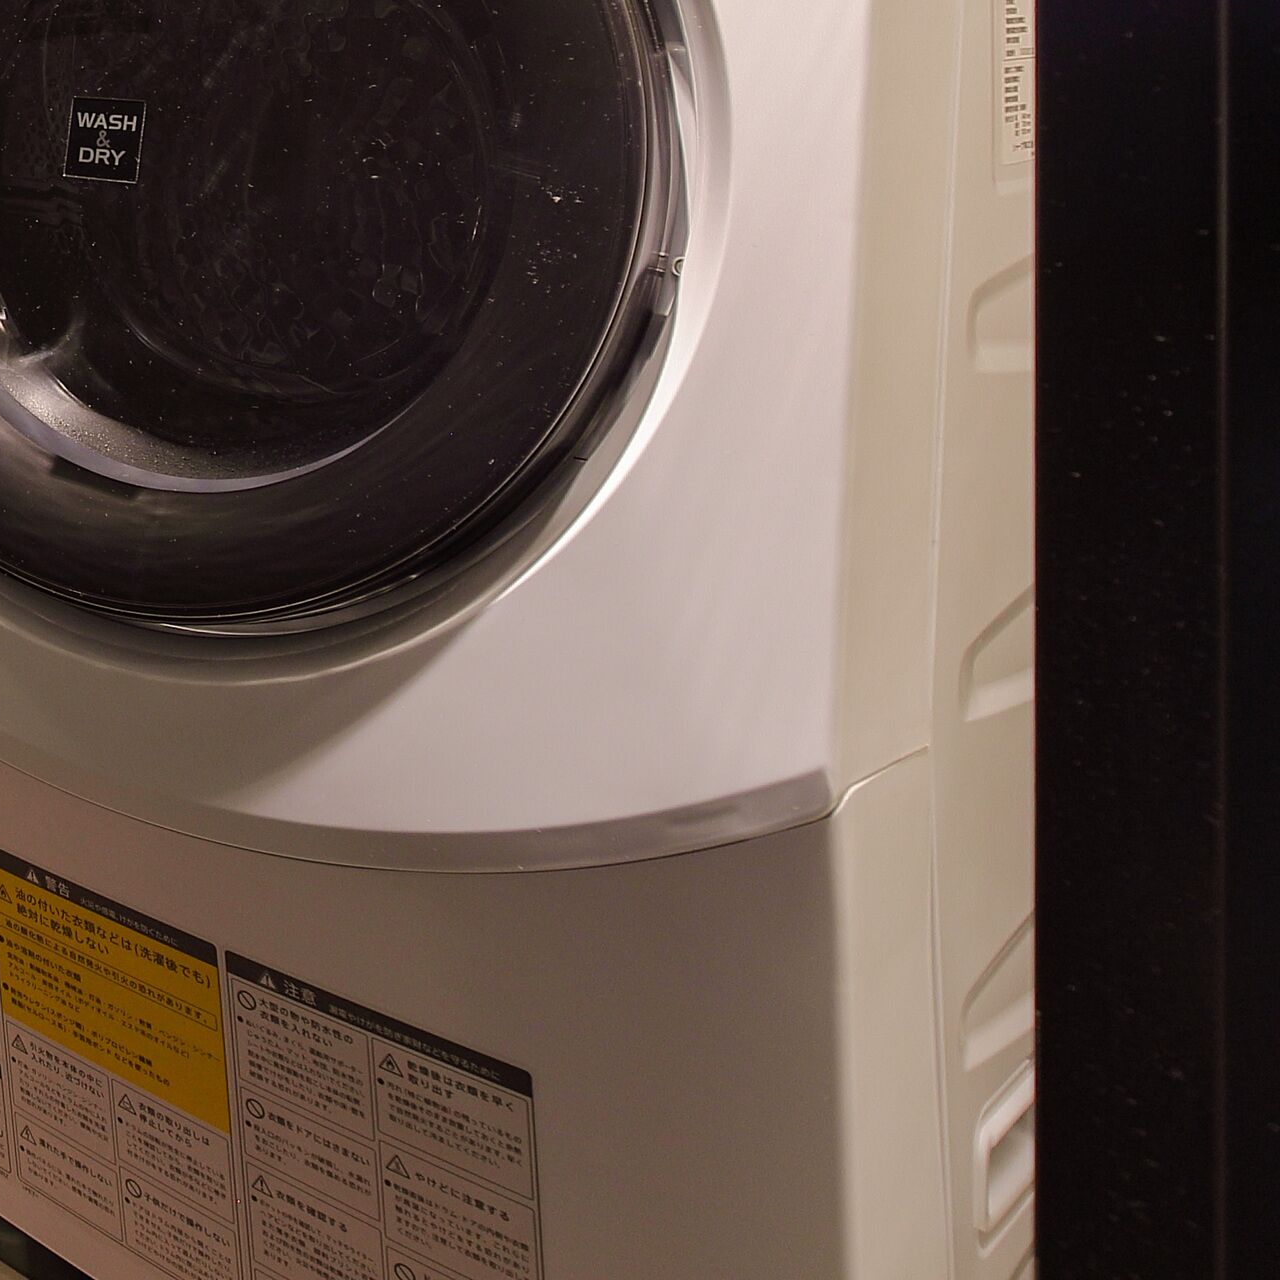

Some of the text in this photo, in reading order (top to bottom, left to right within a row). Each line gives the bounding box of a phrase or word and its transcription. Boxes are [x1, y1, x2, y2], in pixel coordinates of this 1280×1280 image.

[77, 112, 137, 131] WASH
[96, 130, 110, 147] &
[78, 146, 126, 165] DRY
[44, 873, 71, 898] 警告
[15, 887, 212, 989] 油の付いた衣類などは(洗濯後でも)
[16, 902, 110, 954] 絶対に乾燥しない
[5, 938, 82, 983] 油や溶剤の付いた衣類
[282, 978, 318, 1006] 注意
[259, 997, 354, 1045] 大型の物や防水性の
[259, 1010, 334, 1048] 衣類を入れない
[29, 1043, 102, 1088] 引火物を本体の中に
[406, 1060, 514, 1112] 乾燥後は衣類を早く
[408, 1076, 454, 1100] 取り出す
[139, 1102, 210, 1146] 衣類の取り出しは
[139, 1113, 192, 1148] 停止してから
[268, 1112, 371, 1166] 衣類をドアにはさまない
[39, 1139, 113, 1187] 濡れた手で操作しない
[275, 1190, 348, 1233] 衣類を確認する
[415, 1171, 511, 1222] やけどに注意する
[144, 1194, 231, 1247] 子供だけで操作しない
